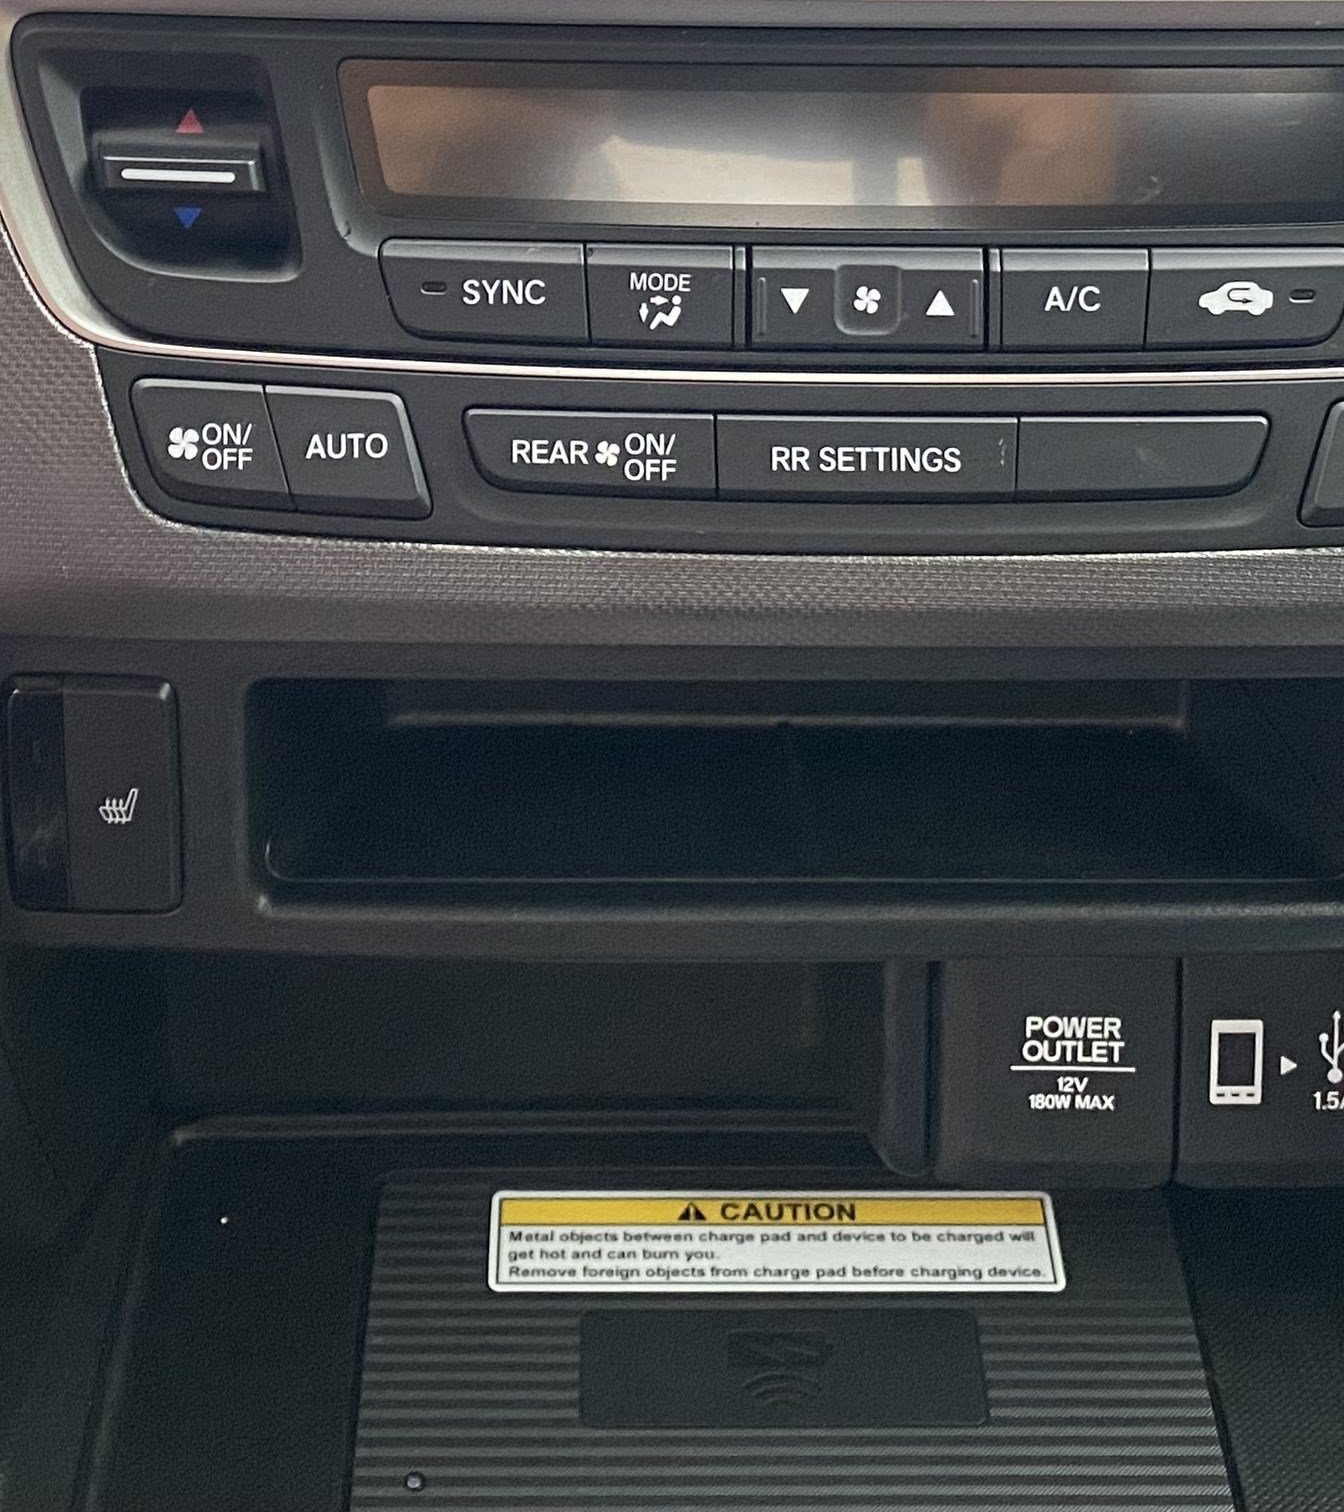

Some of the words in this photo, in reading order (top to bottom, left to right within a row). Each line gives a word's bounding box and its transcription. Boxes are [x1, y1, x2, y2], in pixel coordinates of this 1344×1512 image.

[462, 279, 546, 306] SYNC
[629, 273, 692, 292] MODE
[1044, 286, 1102, 312] A/C
[202, 423, 253, 447] ON/
[305, 432, 389, 459] AUTO
[624, 433, 676, 456] ON/
[202, 447, 253, 471] OFF
[511, 439, 589, 465] REAR
[770, 446, 815, 471] RR
[819, 446, 962, 474] SETTINGS
[624, 458, 677, 482] OFF
[1025, 1016, 1122, 1041] POWER
[1021, 1039, 1125, 1064] OUTLET
[1056, 1076, 1088, 1093] 12V
[1028, 1093, 1073, 1111] 180W
[1075, 1094, 1115, 1111] MAX
[720, 1202, 856, 1222] CAUTION
[508, 1230, 554, 1243] Metal
[559, 1230, 618, 1245] objects
[623, 1230, 693, 1243] between
[699, 1230, 754, 1245] charge
[760, 1230, 791, 1245] pad
[797, 1230, 827, 1243] and
[832, 1230, 886, 1243] device
[891, 1230, 906, 1243] to
[911, 1230, 932, 1243] be
[937, 1230, 1004, 1245] charged
[1009, 1230, 1035, 1243] will
[508, 1249, 534, 1262] get
[540, 1248, 565, 1260] hot
[571, 1248, 602, 1260] and
[607, 1250, 637, 1260] can
[642, 1248, 679, 1260] burn
[684, 1250, 719, 1262] you.
[508, 1266, 577, 1278] Remove
[582, 1266, 640, 1280] foreign
[645, 1266, 706, 1280] objects
[710, 1266, 748, 1278] from
[753, 1266, 810, 1280] charge
[816, 1266, 846, 1280] pad
[852, 1266, 905, 1278] before
[910, 1266, 982, 1280] charging
[987, 1266, 1046, 1278] device.
